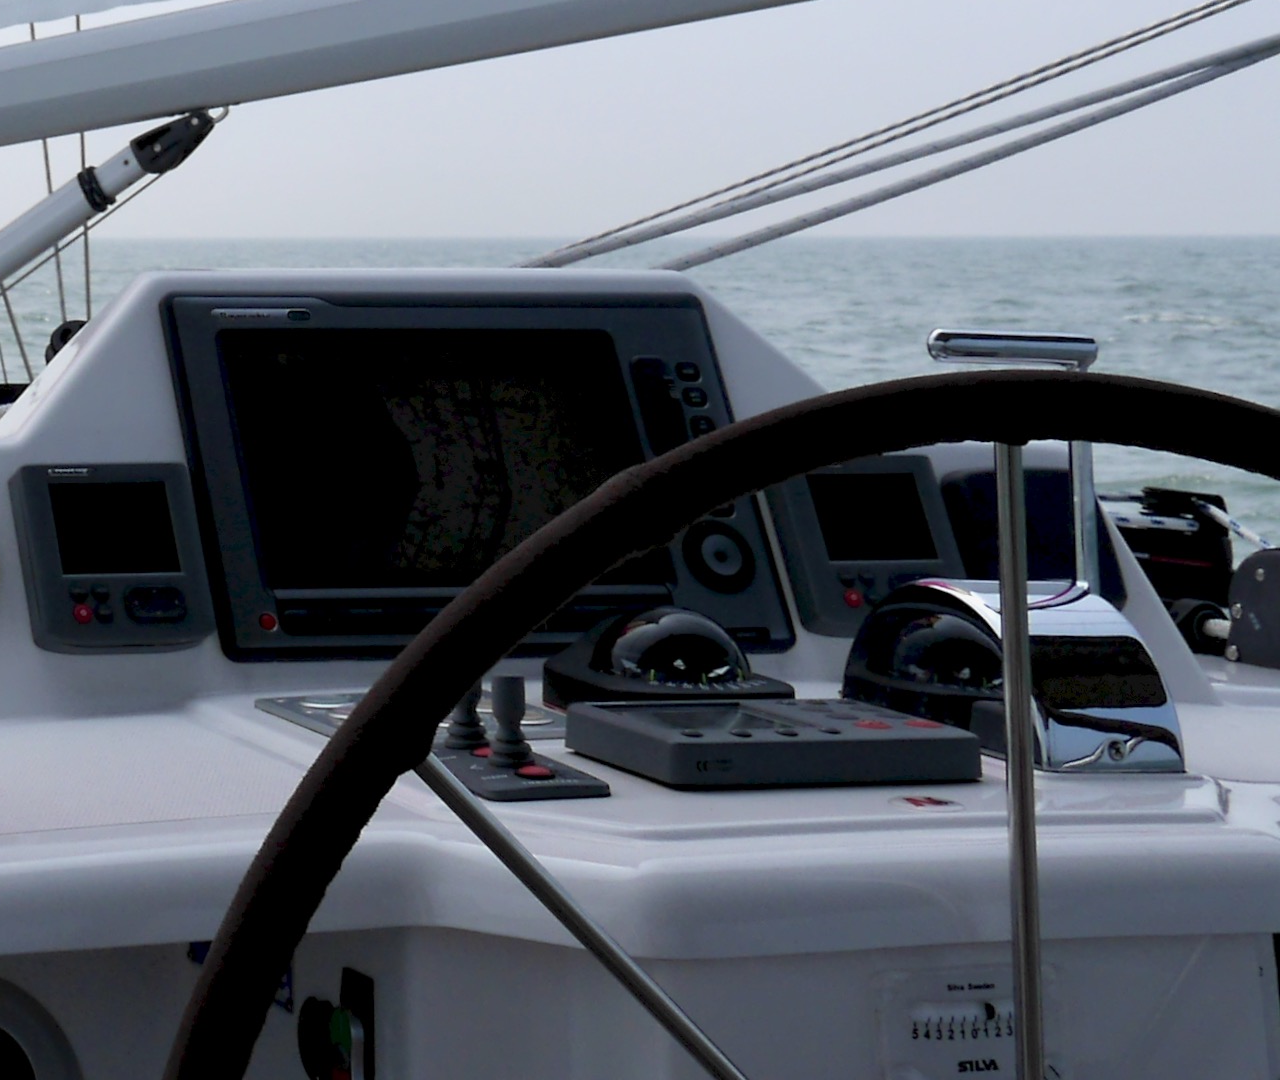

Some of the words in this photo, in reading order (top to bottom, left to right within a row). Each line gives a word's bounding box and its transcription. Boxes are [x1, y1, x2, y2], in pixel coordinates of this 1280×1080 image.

[947, 983, 965, 992] Silva
[968, 982, 995, 991] Sweden
[912, 1028, 919, 1040] 5
[924, 1028, 931, 1040] 4
[936, 1028, 943, 1040] 3
[948, 1028, 955, 1040] 2
[960, 1028, 966, 1040] 1
[983, 1027, 989, 1038] 1
[995, 1026, 1002, 1037] 2
[1006, 1025, 1013, 1036] 3
[958, 1059, 999, 1073] SILVA
